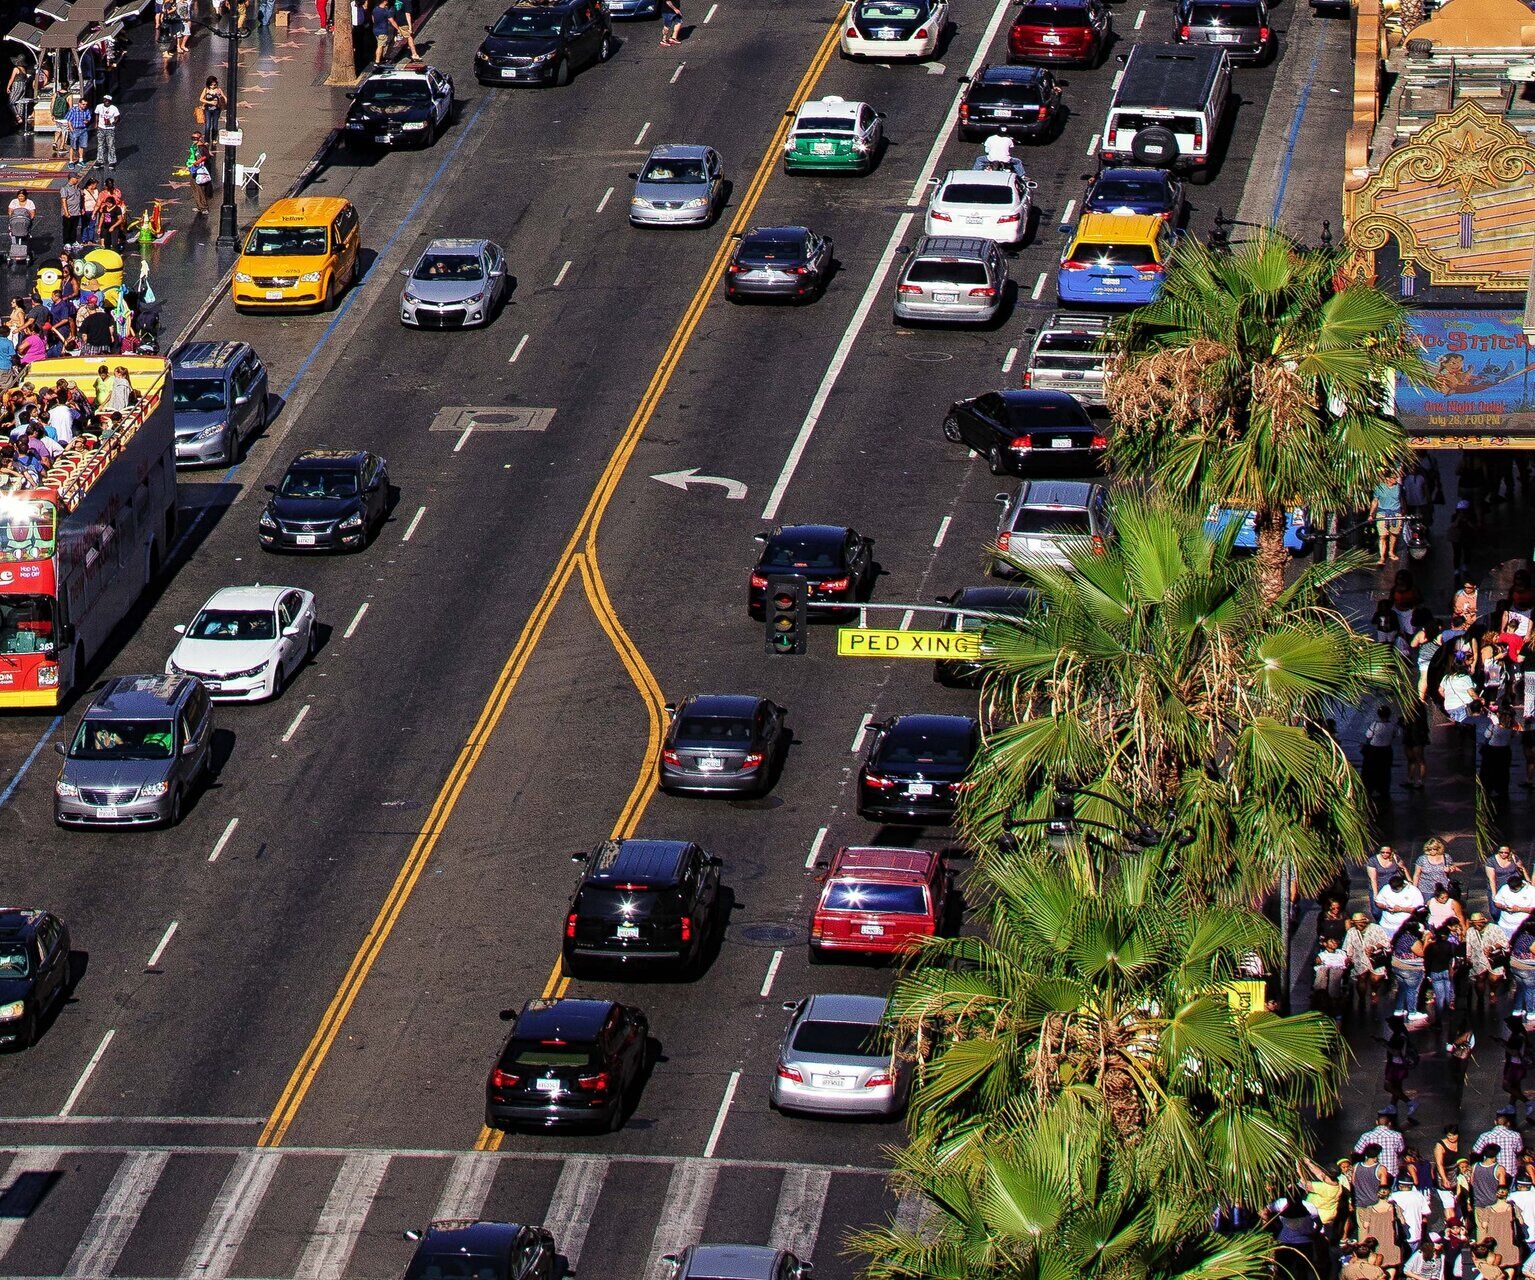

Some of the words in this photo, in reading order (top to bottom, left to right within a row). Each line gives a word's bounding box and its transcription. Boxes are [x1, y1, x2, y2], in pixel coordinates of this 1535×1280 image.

[281, 215, 306, 223] Yellow
[1427, 414, 1447, 427] July
[39, 643, 54, 651] 363
[850, 633, 899, 652] PED
[911, 635, 970, 654] XING
